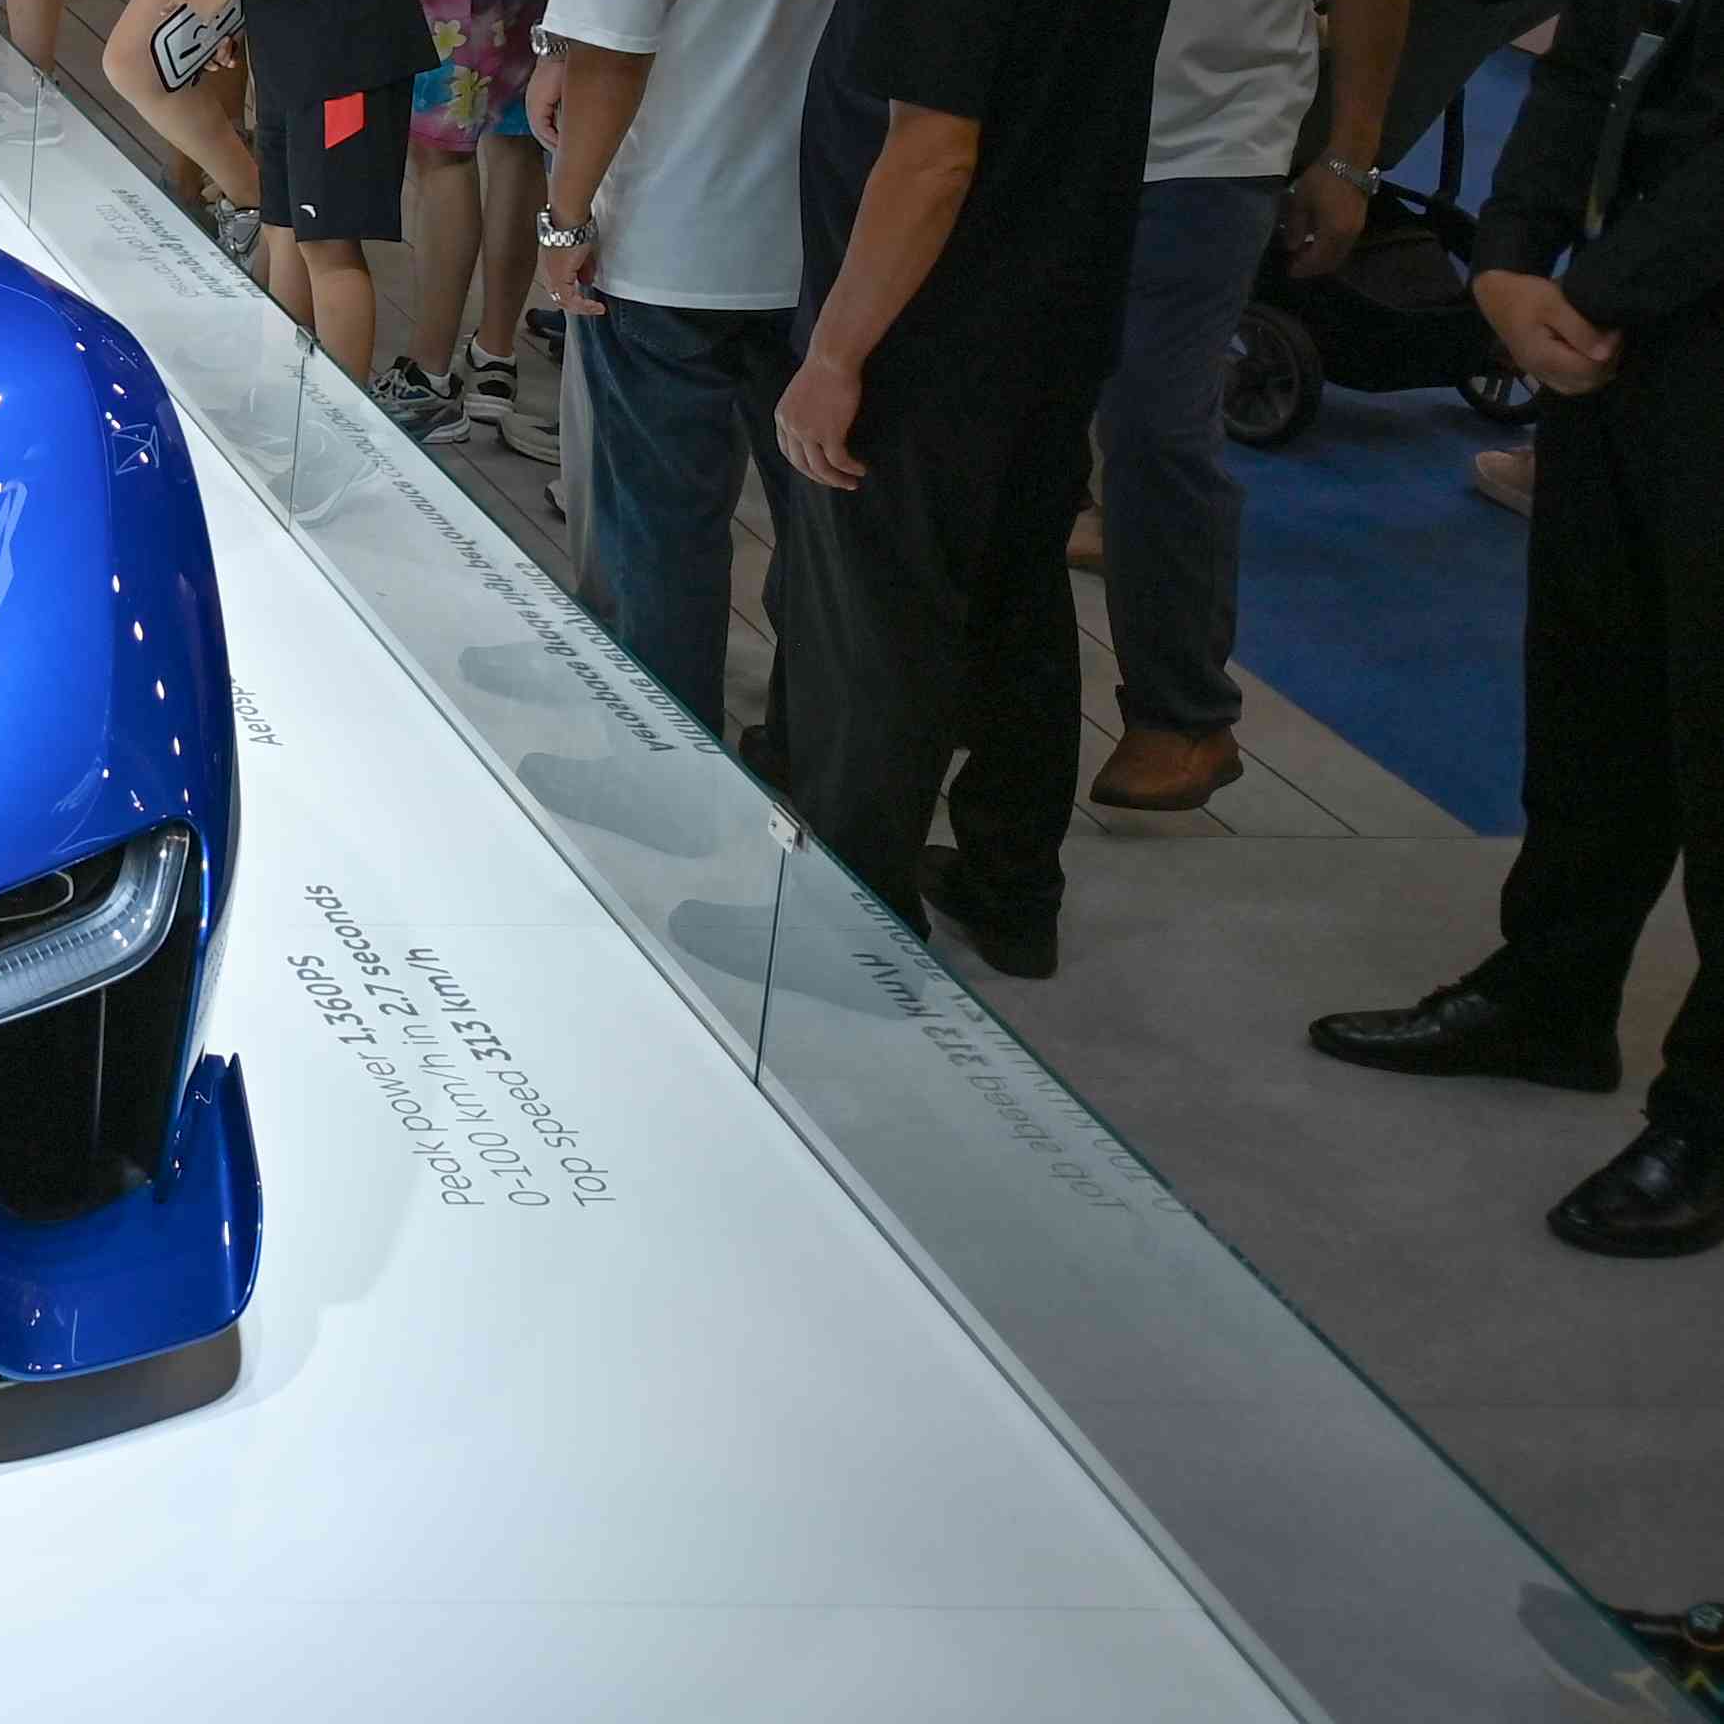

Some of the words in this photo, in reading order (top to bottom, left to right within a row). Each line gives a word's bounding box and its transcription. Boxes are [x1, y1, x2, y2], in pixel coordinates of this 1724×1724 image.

[233, 678, 283, 747] Aerosp
[304, 884, 391, 978] seconds
[288, 954, 377, 1044] 1,360PS
[363, 982, 419, 1016] 2.7
[404, 948, 477, 1013] km/h
[402, 1024, 440, 1045] in
[450, 1019, 512, 1063] 313
[357, 1052, 449, 1131] power
[418, 1053, 495, 1122] km/h
[498, 1069, 580, 1149] speed
[412, 1142, 485, 1206] Peak
[468, 1131, 551, 1207] 0-100
[560, 1158, 616, 1208] Top
